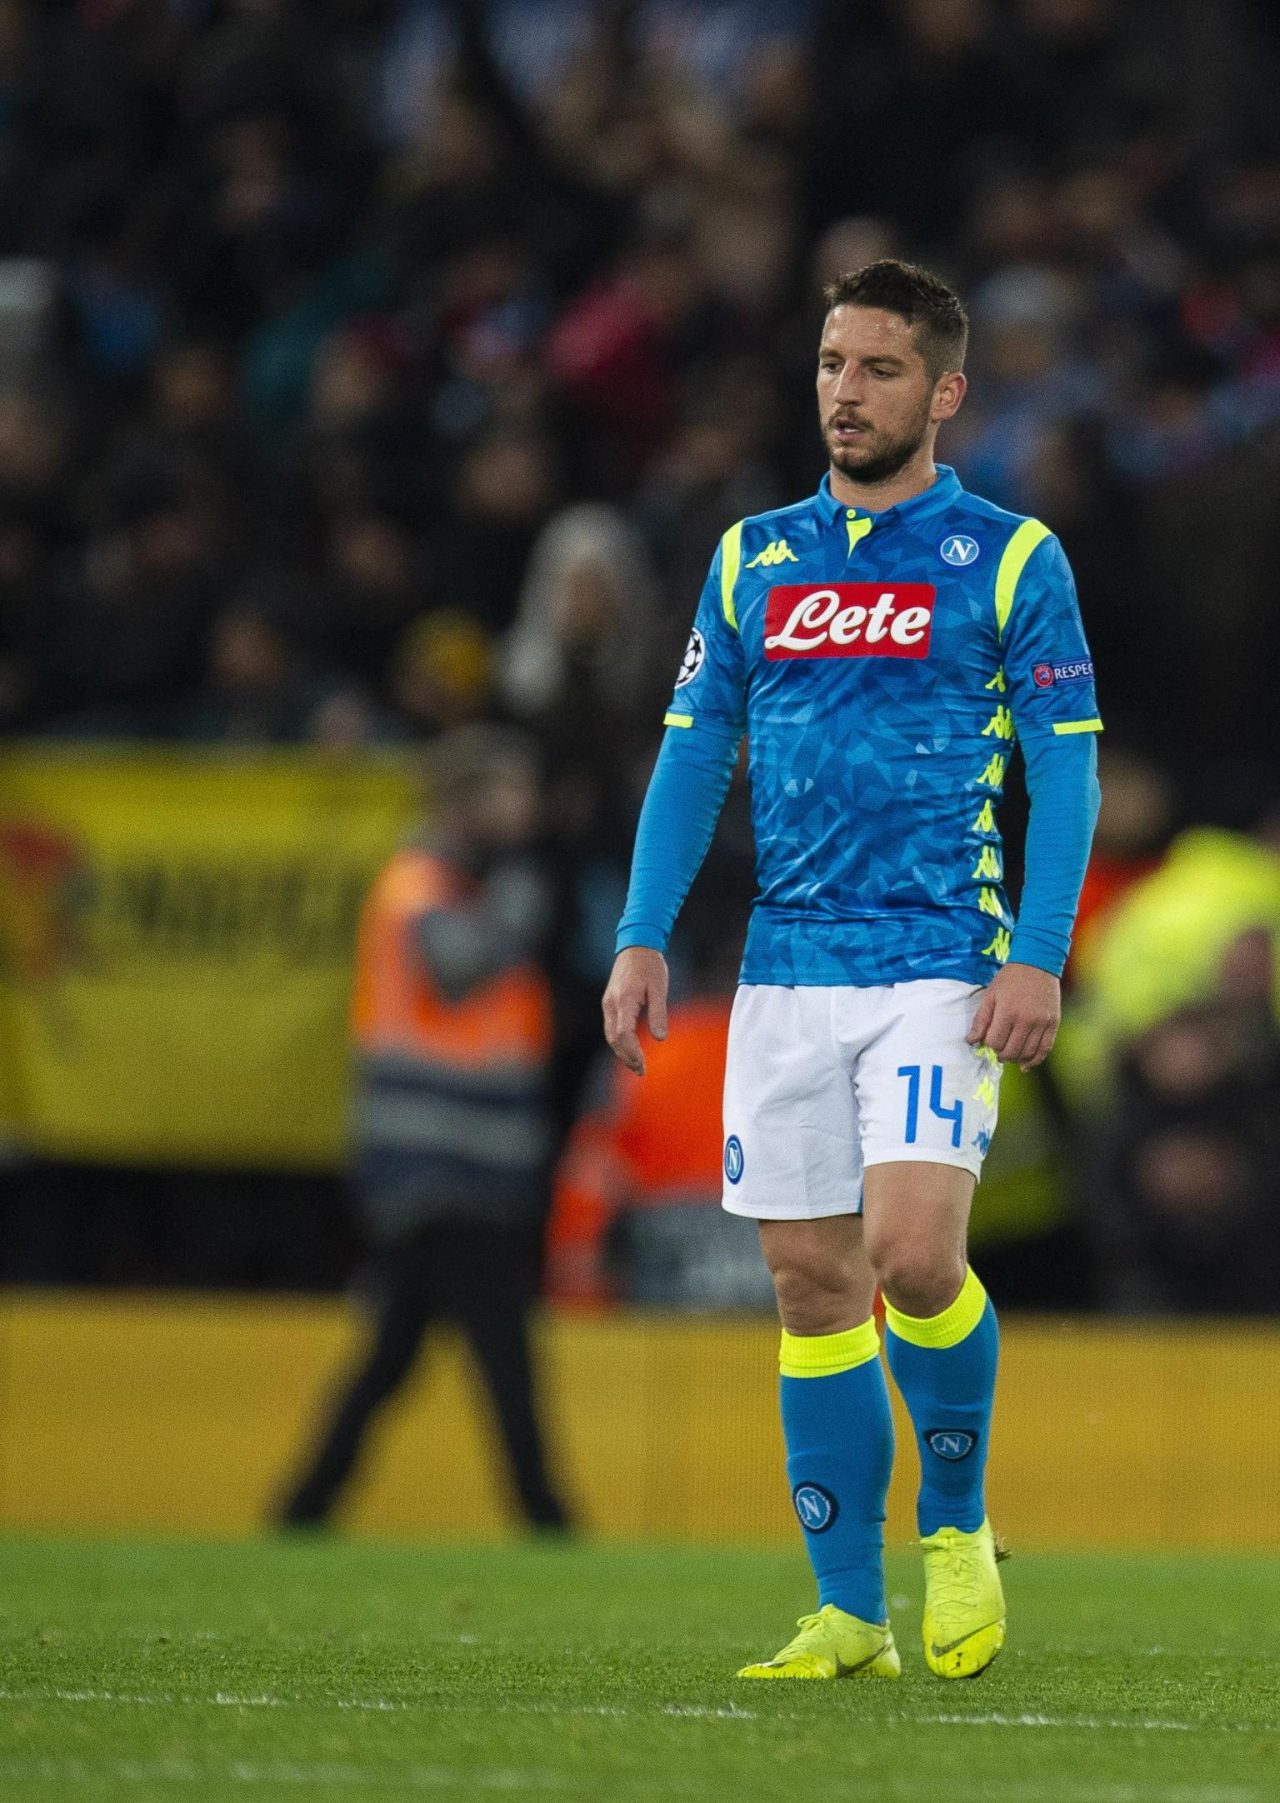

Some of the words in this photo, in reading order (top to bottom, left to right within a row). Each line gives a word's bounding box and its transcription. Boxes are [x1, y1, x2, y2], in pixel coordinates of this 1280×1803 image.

[946, 539, 974, 561] N
[765, 589, 930, 649] Lete
[898, 1065, 963, 1148] 14
[729, 1147, 738, 1171] N
[941, 1435, 961, 1453] N
[801, 1495, 820, 1520] N
